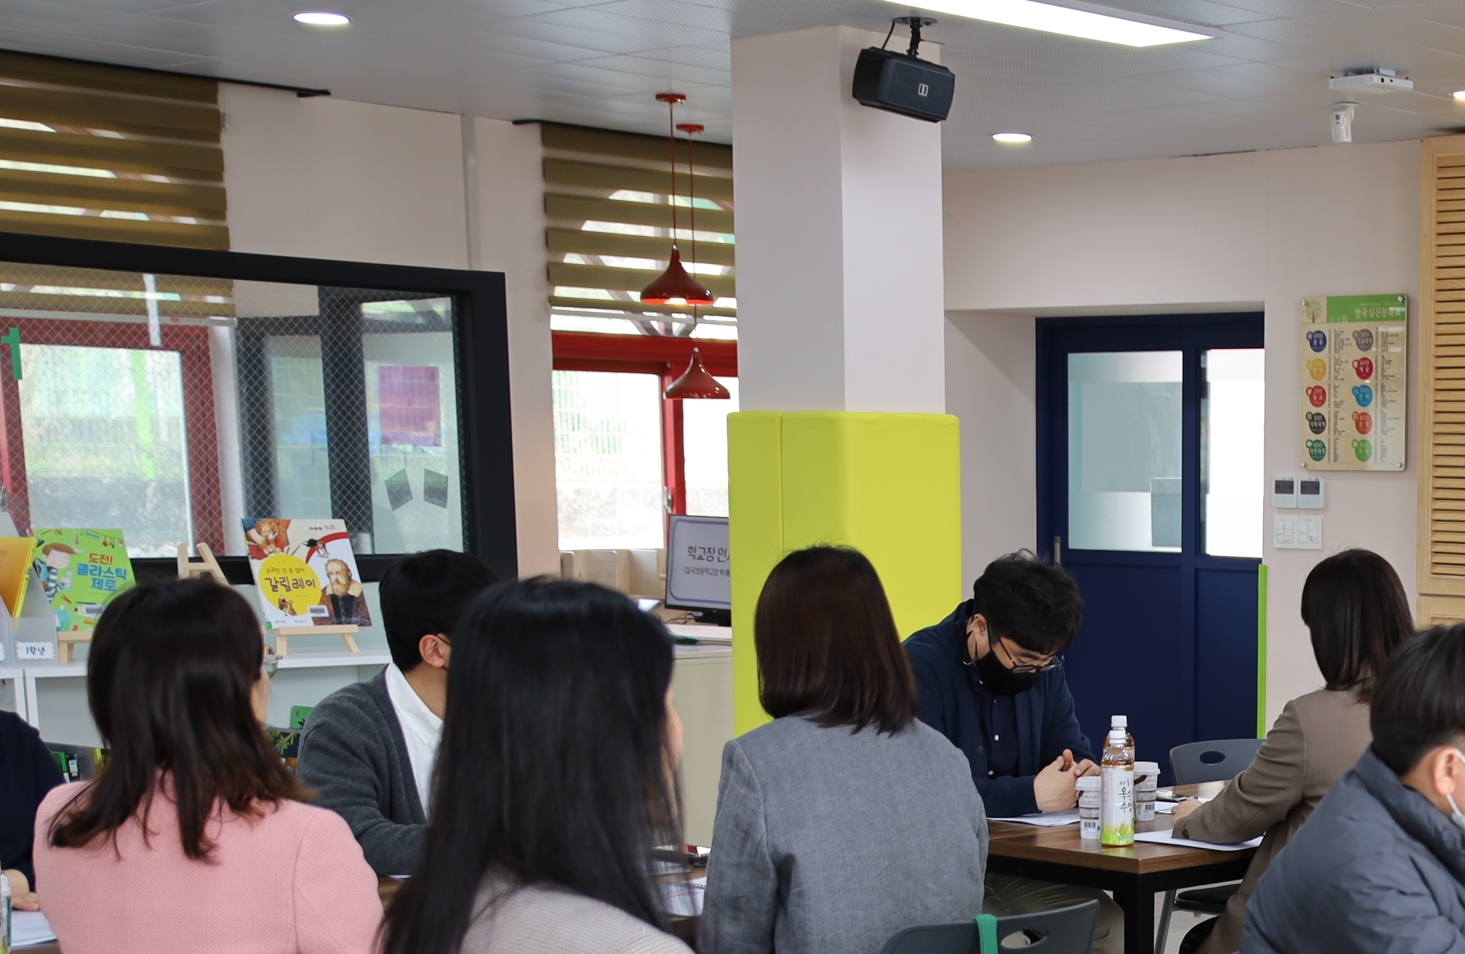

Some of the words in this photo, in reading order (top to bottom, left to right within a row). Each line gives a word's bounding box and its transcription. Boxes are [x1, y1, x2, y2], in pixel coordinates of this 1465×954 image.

[88, 552, 113, 566] 도전!
[717, 547, 730, 563] 인
[91, 577, 117, 592] 제로
[264, 576, 316, 592] 갈릴레이
[26, 645, 45, 655] 1학년
